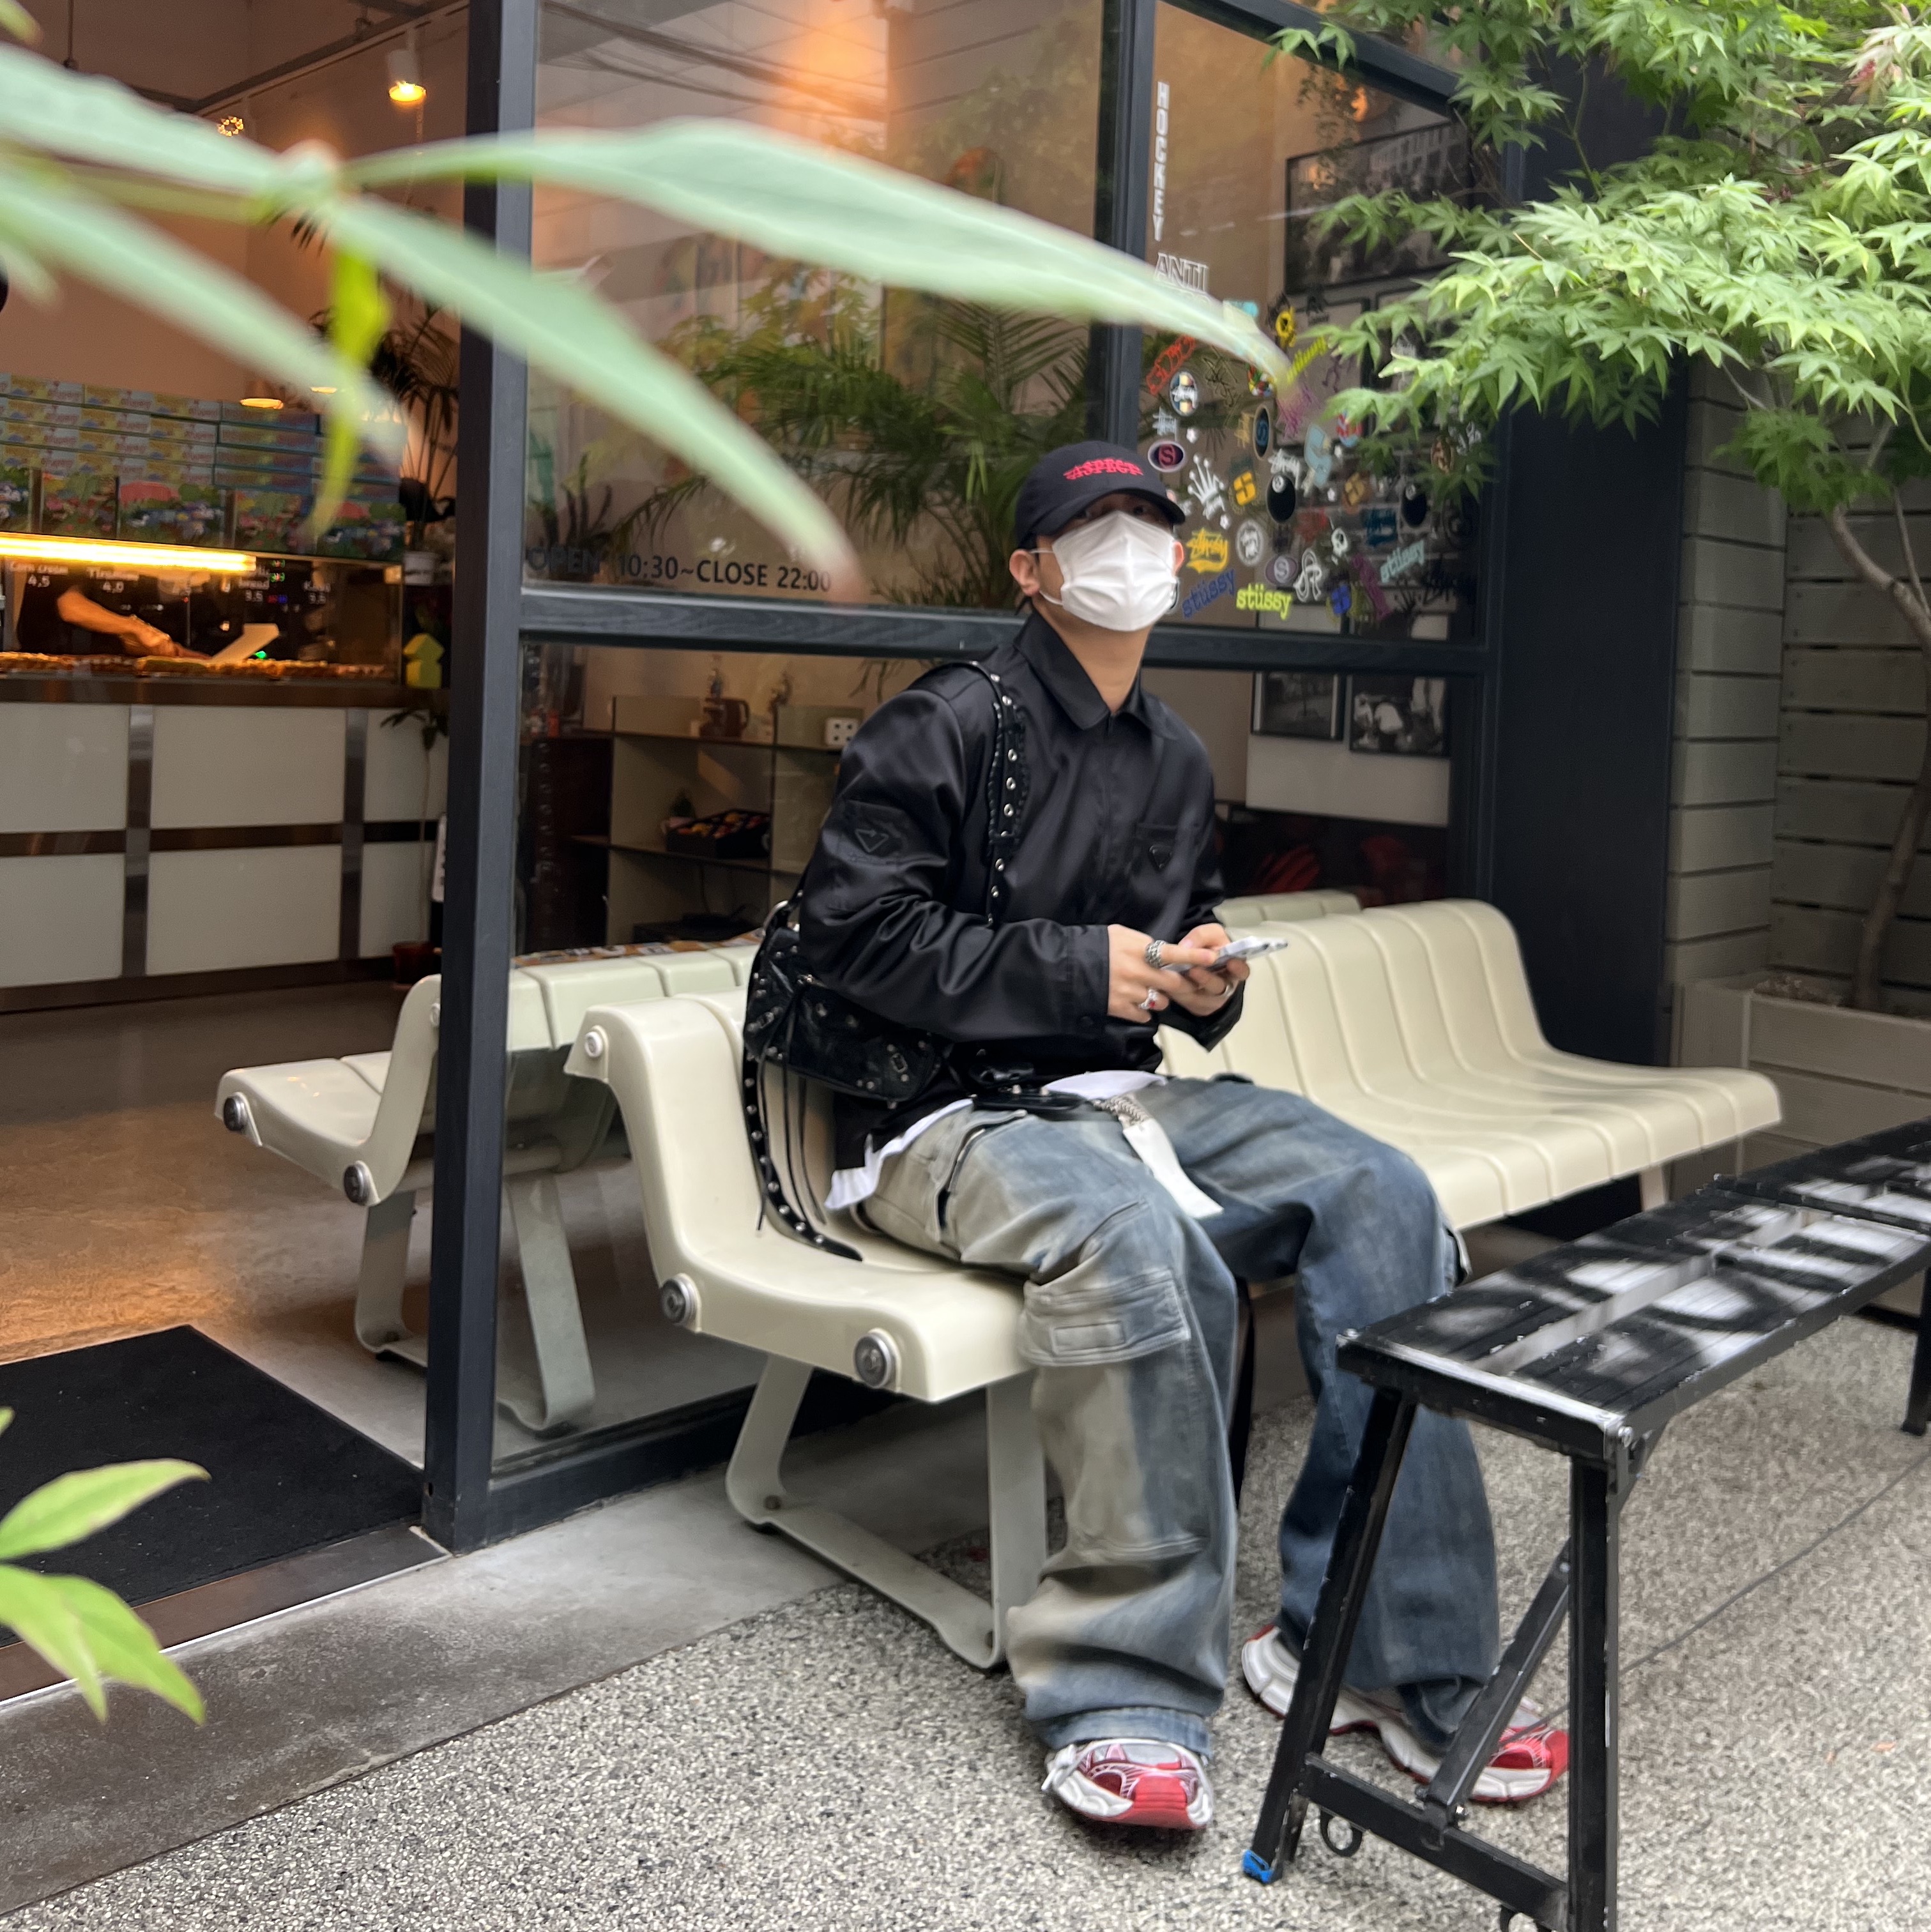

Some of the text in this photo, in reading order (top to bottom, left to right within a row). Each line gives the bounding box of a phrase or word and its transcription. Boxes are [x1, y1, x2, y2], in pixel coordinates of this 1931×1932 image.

[1152, 81, 1170, 242] HOCKEY
[1154, 252, 1209, 295] ANTI
[526, 546, 600, 574] OPEN
[777, 566, 832, 592] 22:00
[1236, 582, 1293, 620] stüssy
